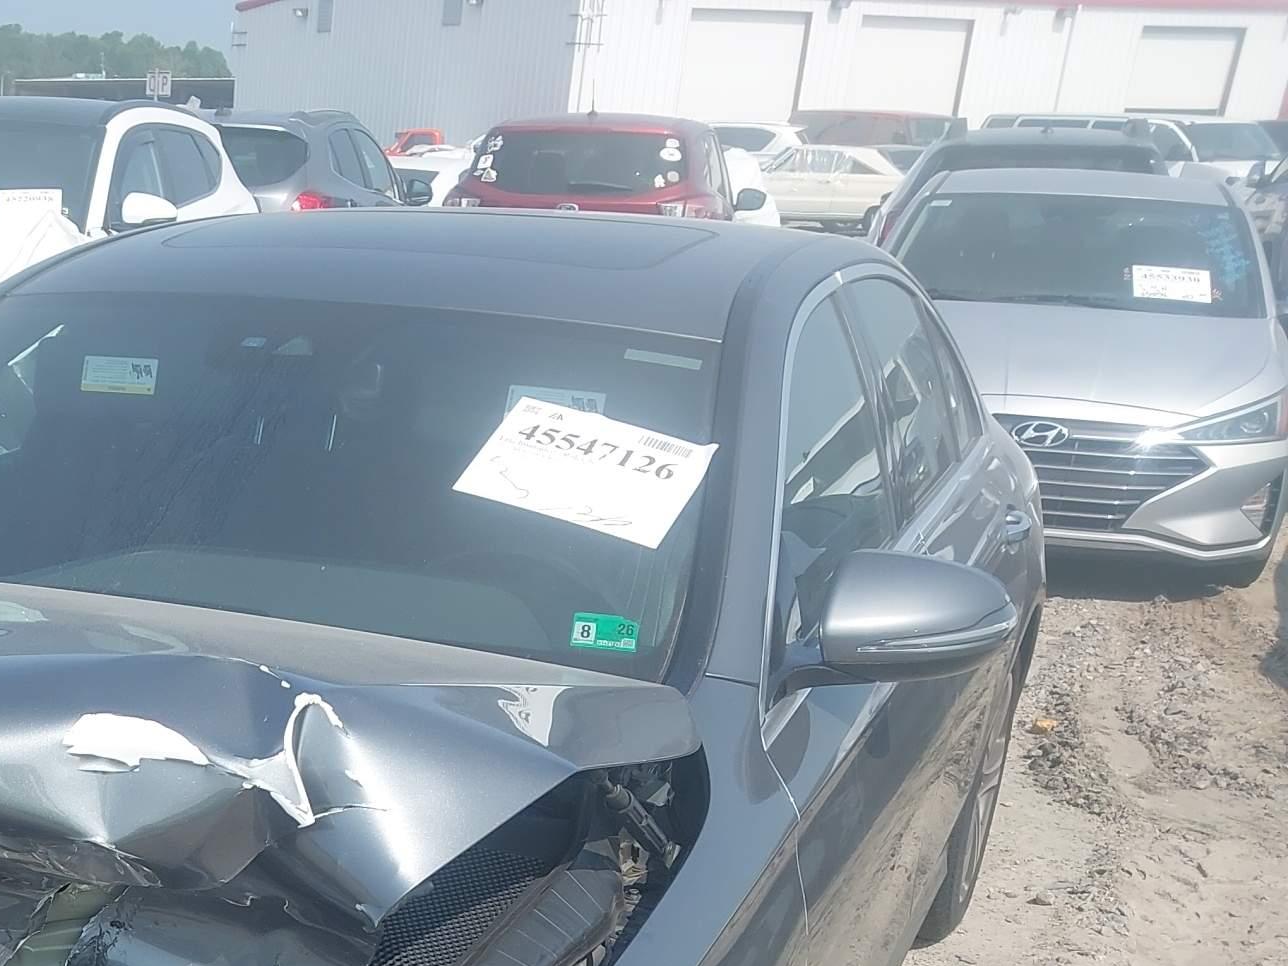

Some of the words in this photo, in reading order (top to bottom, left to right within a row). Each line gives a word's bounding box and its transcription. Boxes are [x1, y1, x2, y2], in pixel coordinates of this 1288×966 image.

[518, 424, 679, 480] 45547126
[580, 624, 592, 639] 8
[617, 623, 635, 636] 26
